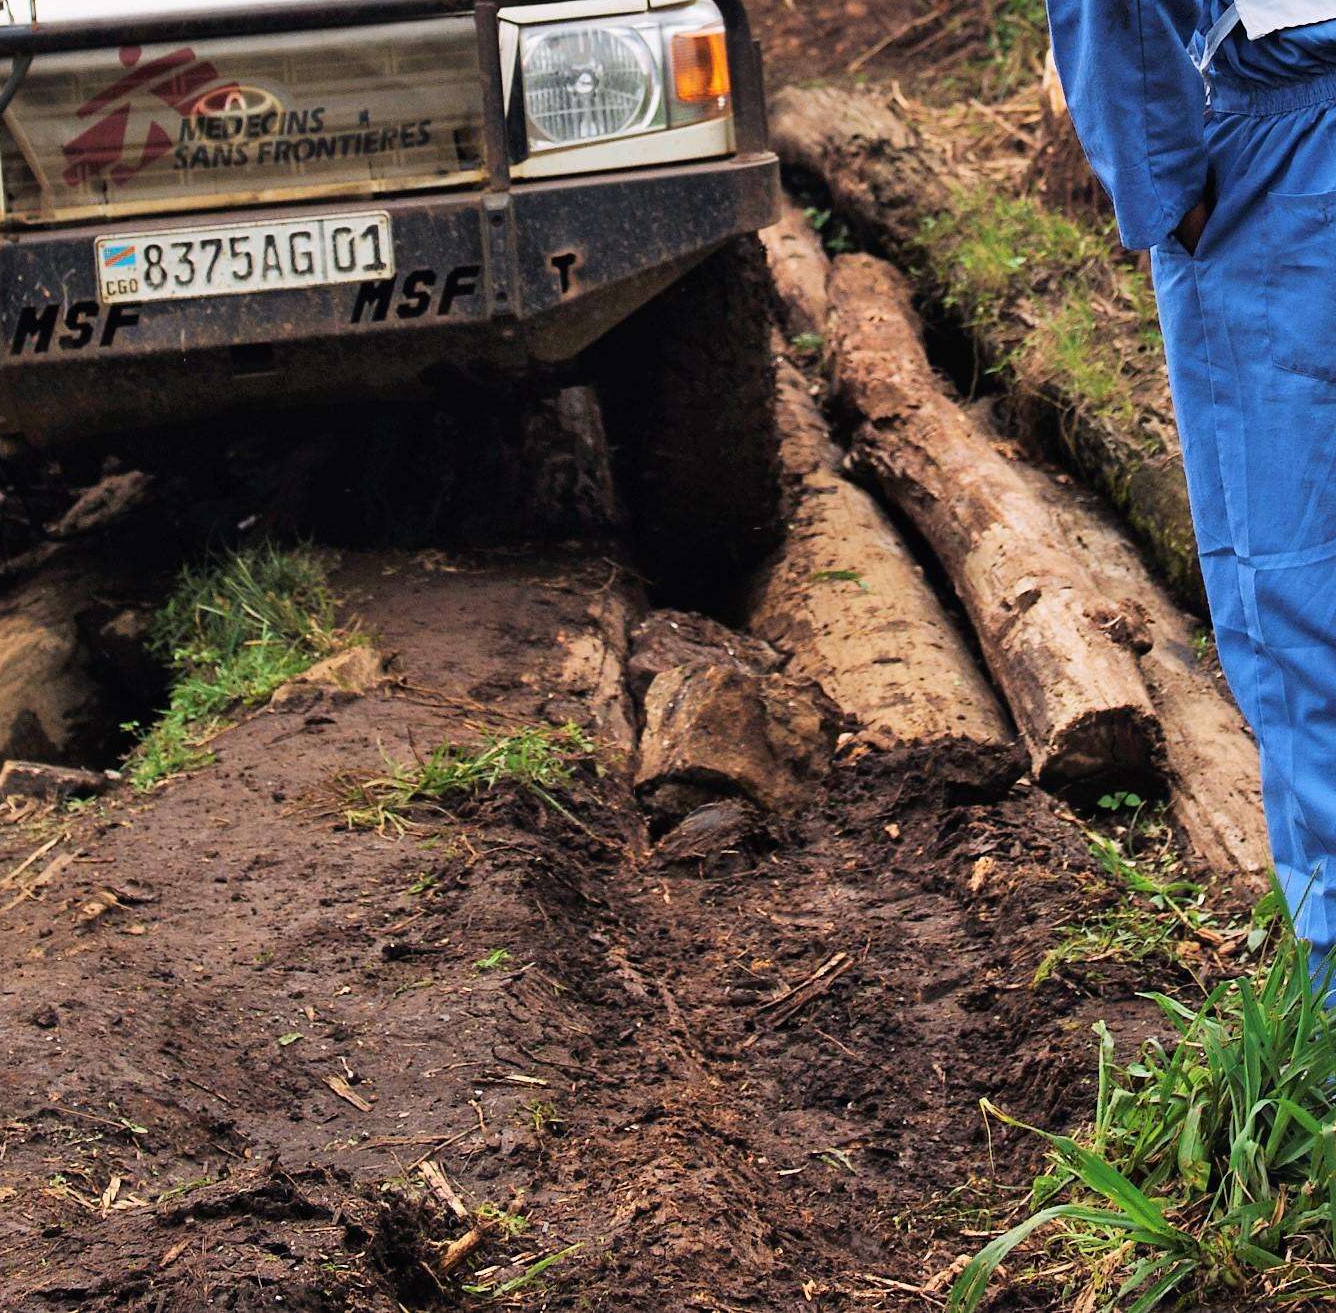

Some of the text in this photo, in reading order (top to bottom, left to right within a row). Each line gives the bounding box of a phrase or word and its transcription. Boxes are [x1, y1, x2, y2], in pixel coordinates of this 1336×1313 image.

[172, 119, 432, 170] SANS FRONTIERES
[177, 107, 325, 142] MEDECINS
[105, 278, 139, 297] CGO
[350, 264, 481, 324] MSF
[10, 300, 142, 355] MSF
